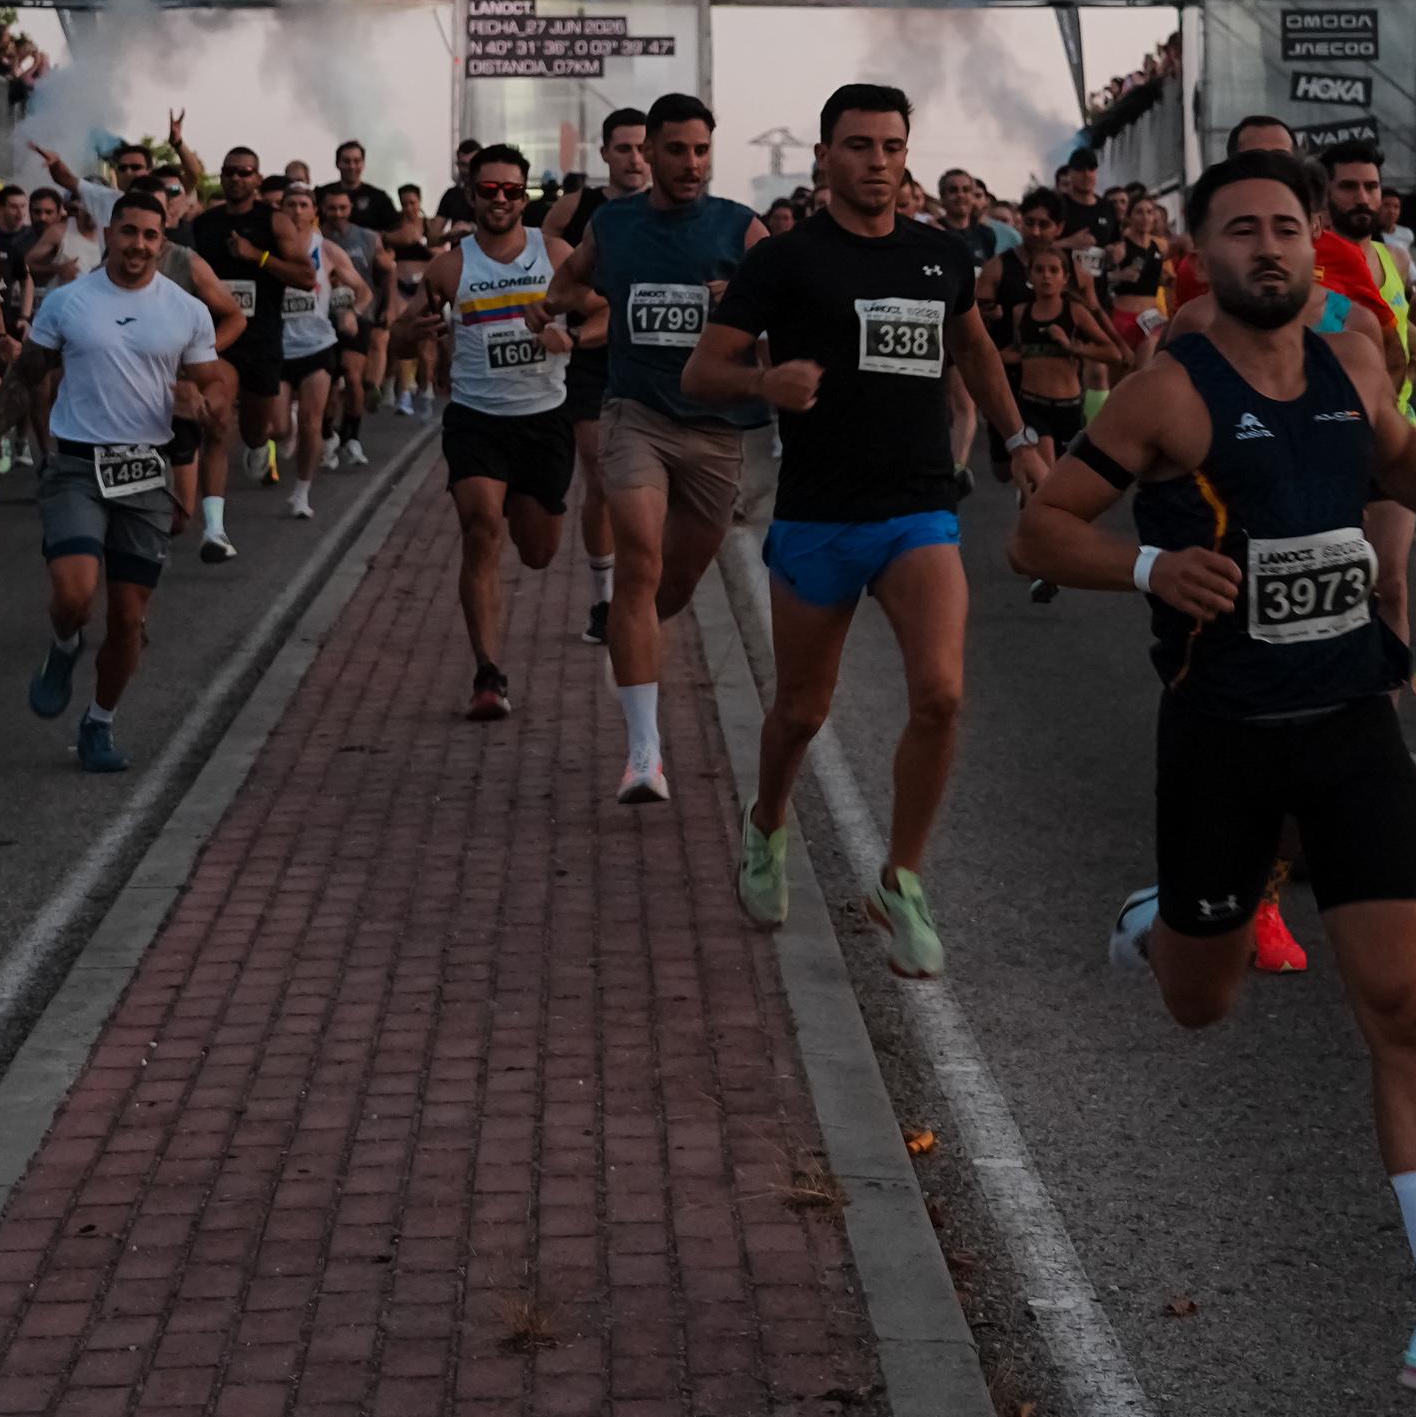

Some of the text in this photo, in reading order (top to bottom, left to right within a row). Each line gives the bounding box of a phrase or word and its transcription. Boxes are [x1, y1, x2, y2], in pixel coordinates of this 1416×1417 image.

[1285, 13, 1373, 30] OMODA
[1287, 41, 1376, 57] JAECOO
[1295, 75, 1366, 103] HOKA
[1310, 125, 1376, 145] VARTA
[469, 275, 547, 293] COLOMBIA
[636, 306, 700, 331] 1799
[877, 324, 929, 357] 338
[492, 342, 546, 365] 1602
[102, 457, 160, 486] 1482
[1263, 566, 1367, 621] 3973
